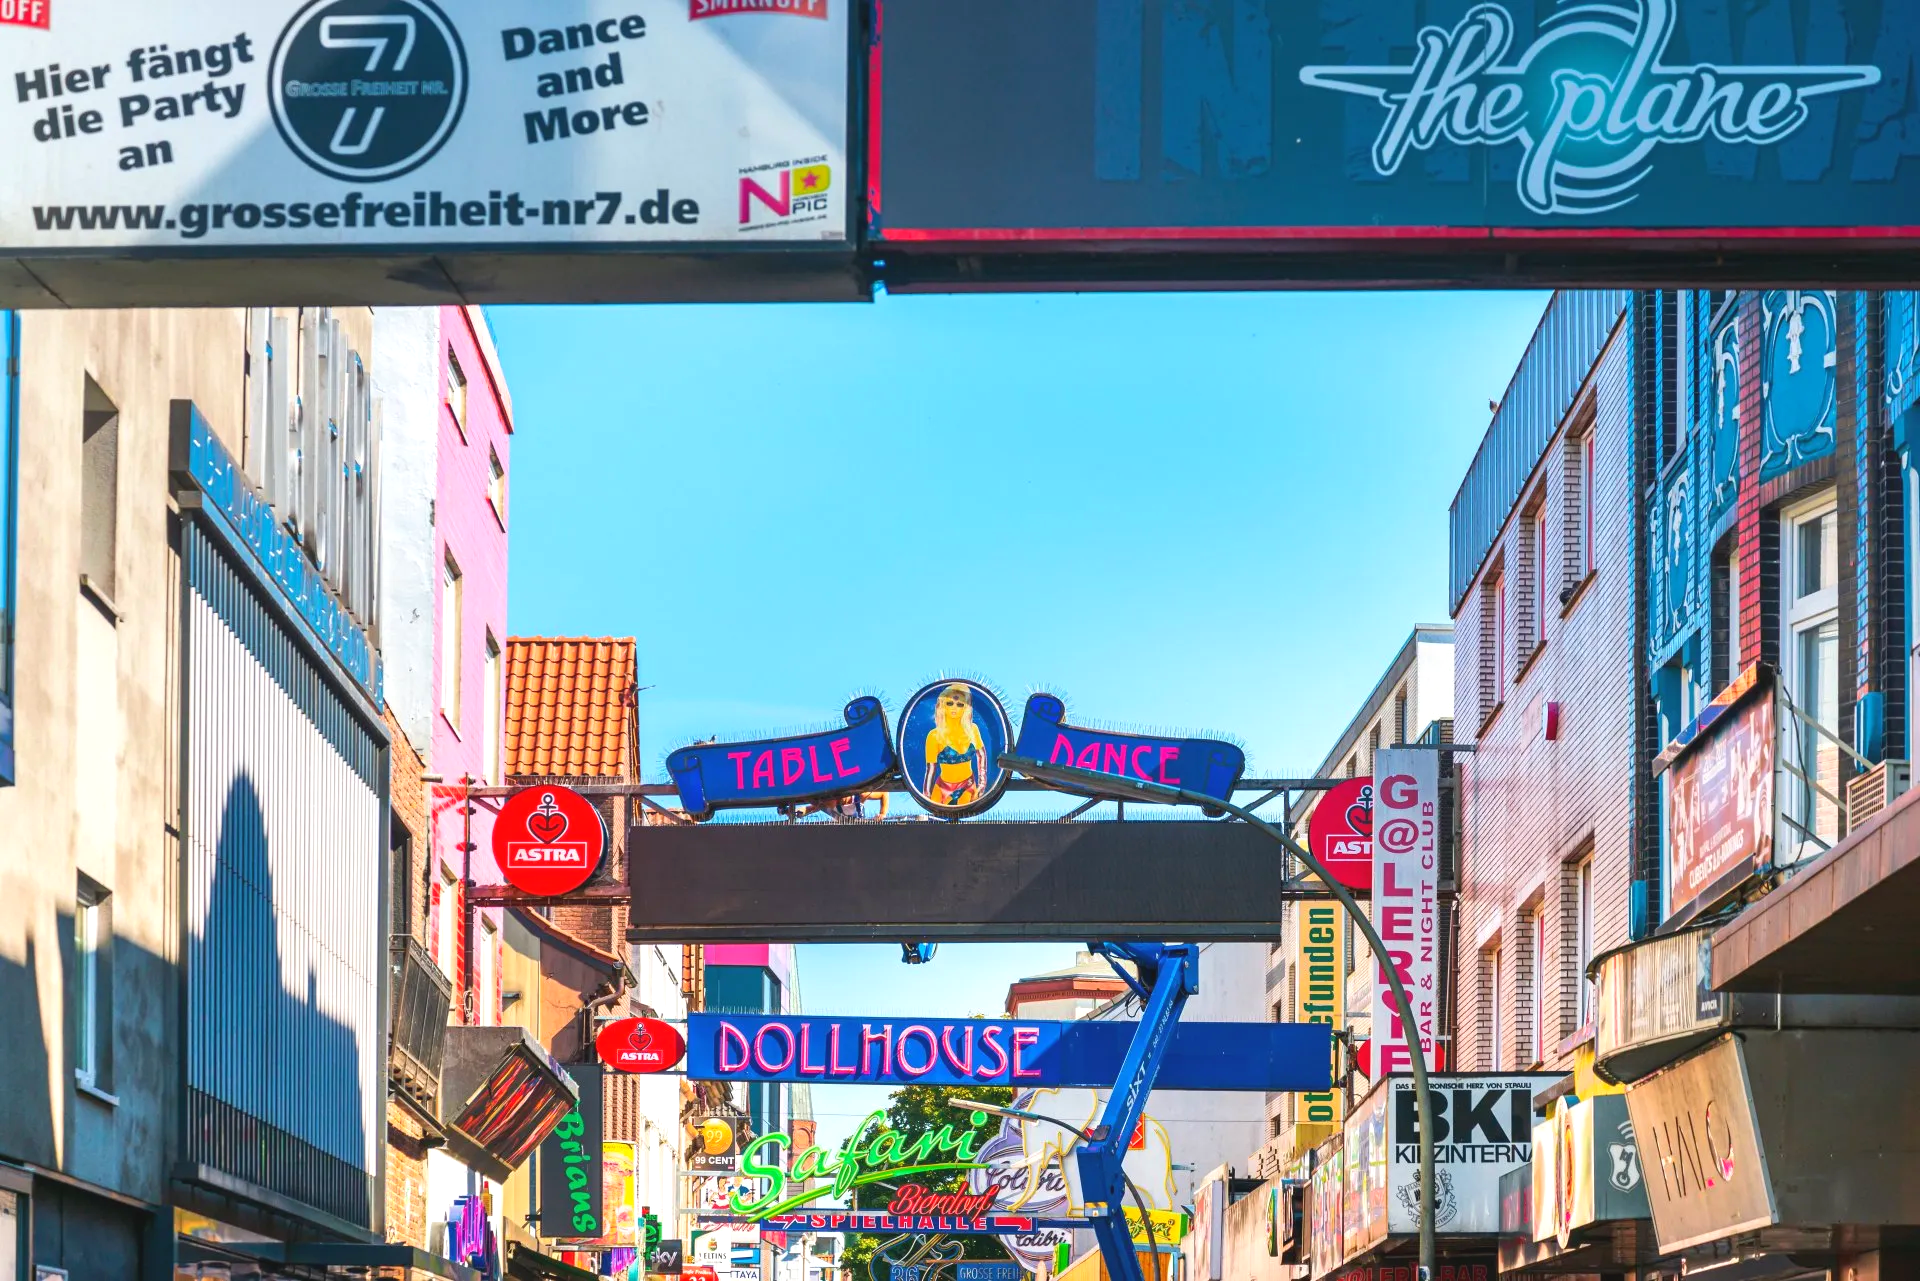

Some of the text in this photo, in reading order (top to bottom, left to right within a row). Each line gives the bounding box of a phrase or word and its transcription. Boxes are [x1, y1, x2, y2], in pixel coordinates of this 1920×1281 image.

[501, 14, 646, 60] Dance
[15, 32, 254, 103] Hier fängt
[536, 52, 624, 98] and
[33, 80, 246, 142] die Party
[524, 101, 649, 144] More
[1376, 6, 1528, 174] the
[1520, 0, 1805, 210] plane
[118, 139, 172, 171] an
[739, 154, 828, 174] HAMBURG INSIDE
[33, 189, 699, 238] www.grossefreiheit-nr7.de
[792, 199, 828, 215] PIC
[727, 737, 860, 790] TABLE
[1050, 733, 1181, 784] DANCE
[514, 847, 580, 862] ASTRA
[1332, 841, 1373, 855] AST
[1420, 801, 1434, 1053] BAR & NIGHT CLUB
[620, 1052, 660, 1061] ASTRA
[719, 1020, 1042, 1077] DOLLHOUSE
[554, 1102, 597, 1233] Brians
[695, 1156, 734, 1165] 99 CENT
[810, 1214, 988, 1230] SPIELHALLE
[888, 1181, 1000, 1222] Bierdorf
[651, 1247, 678, 1267] sky
[960, 1267, 993, 1280] GROSSE
